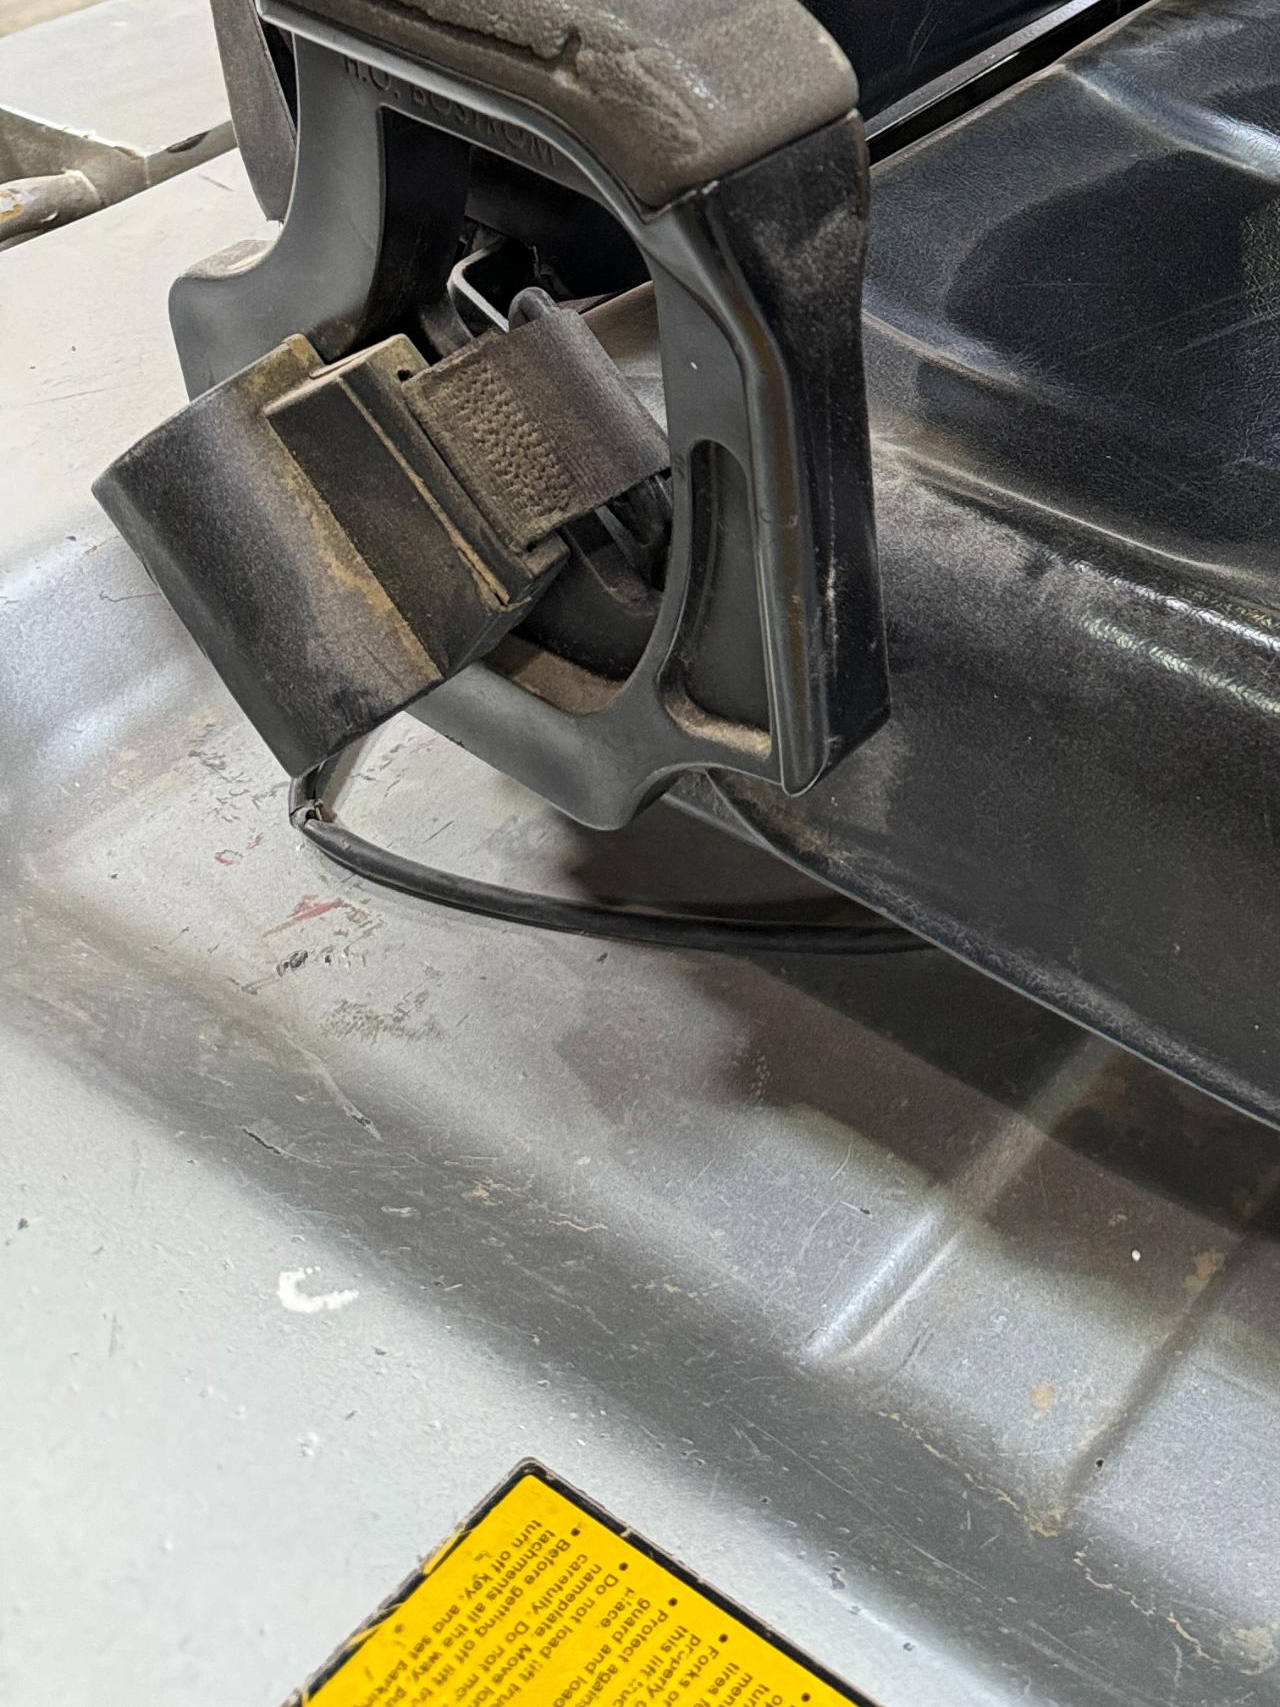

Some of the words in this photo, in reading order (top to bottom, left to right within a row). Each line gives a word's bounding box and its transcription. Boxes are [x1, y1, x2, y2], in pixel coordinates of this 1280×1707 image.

[512, 1520, 542, 1548] turn
[486, 1530, 555, 1600] tachments
[491, 1551, 511, 1573] off
[524, 1539, 570, 1585] Before
[595, 1574, 619, 1595] Do
[433, 1605, 460, 1633] and
[468, 1603, 485, 1623] all
[571, 1598, 595, 1623] not
[612, 1598, 650, 1644] guard
[443, 1624, 468, 1647] the
[506, 1621, 529, 1643] Do
[540, 1625, 573, 1659] load
[618, 1610, 668, 1662] Protect
[661, 1626, 688, 1653] this
[410, 1636, 431, 1660] set
[456, 1640, 475, 1663] off
[480, 1646, 504, 1672] not
[585, 1645, 611, 1675] and
[433, 1665, 454, 1686] lift
[492, 1644, 532, 1684] Move
[679, 1646, 719, 1688] Forks
[708, 1663, 739, 1695] tires
[719, 1673, 752, 1707] men
[744, 1684, 770, 1707] tur
